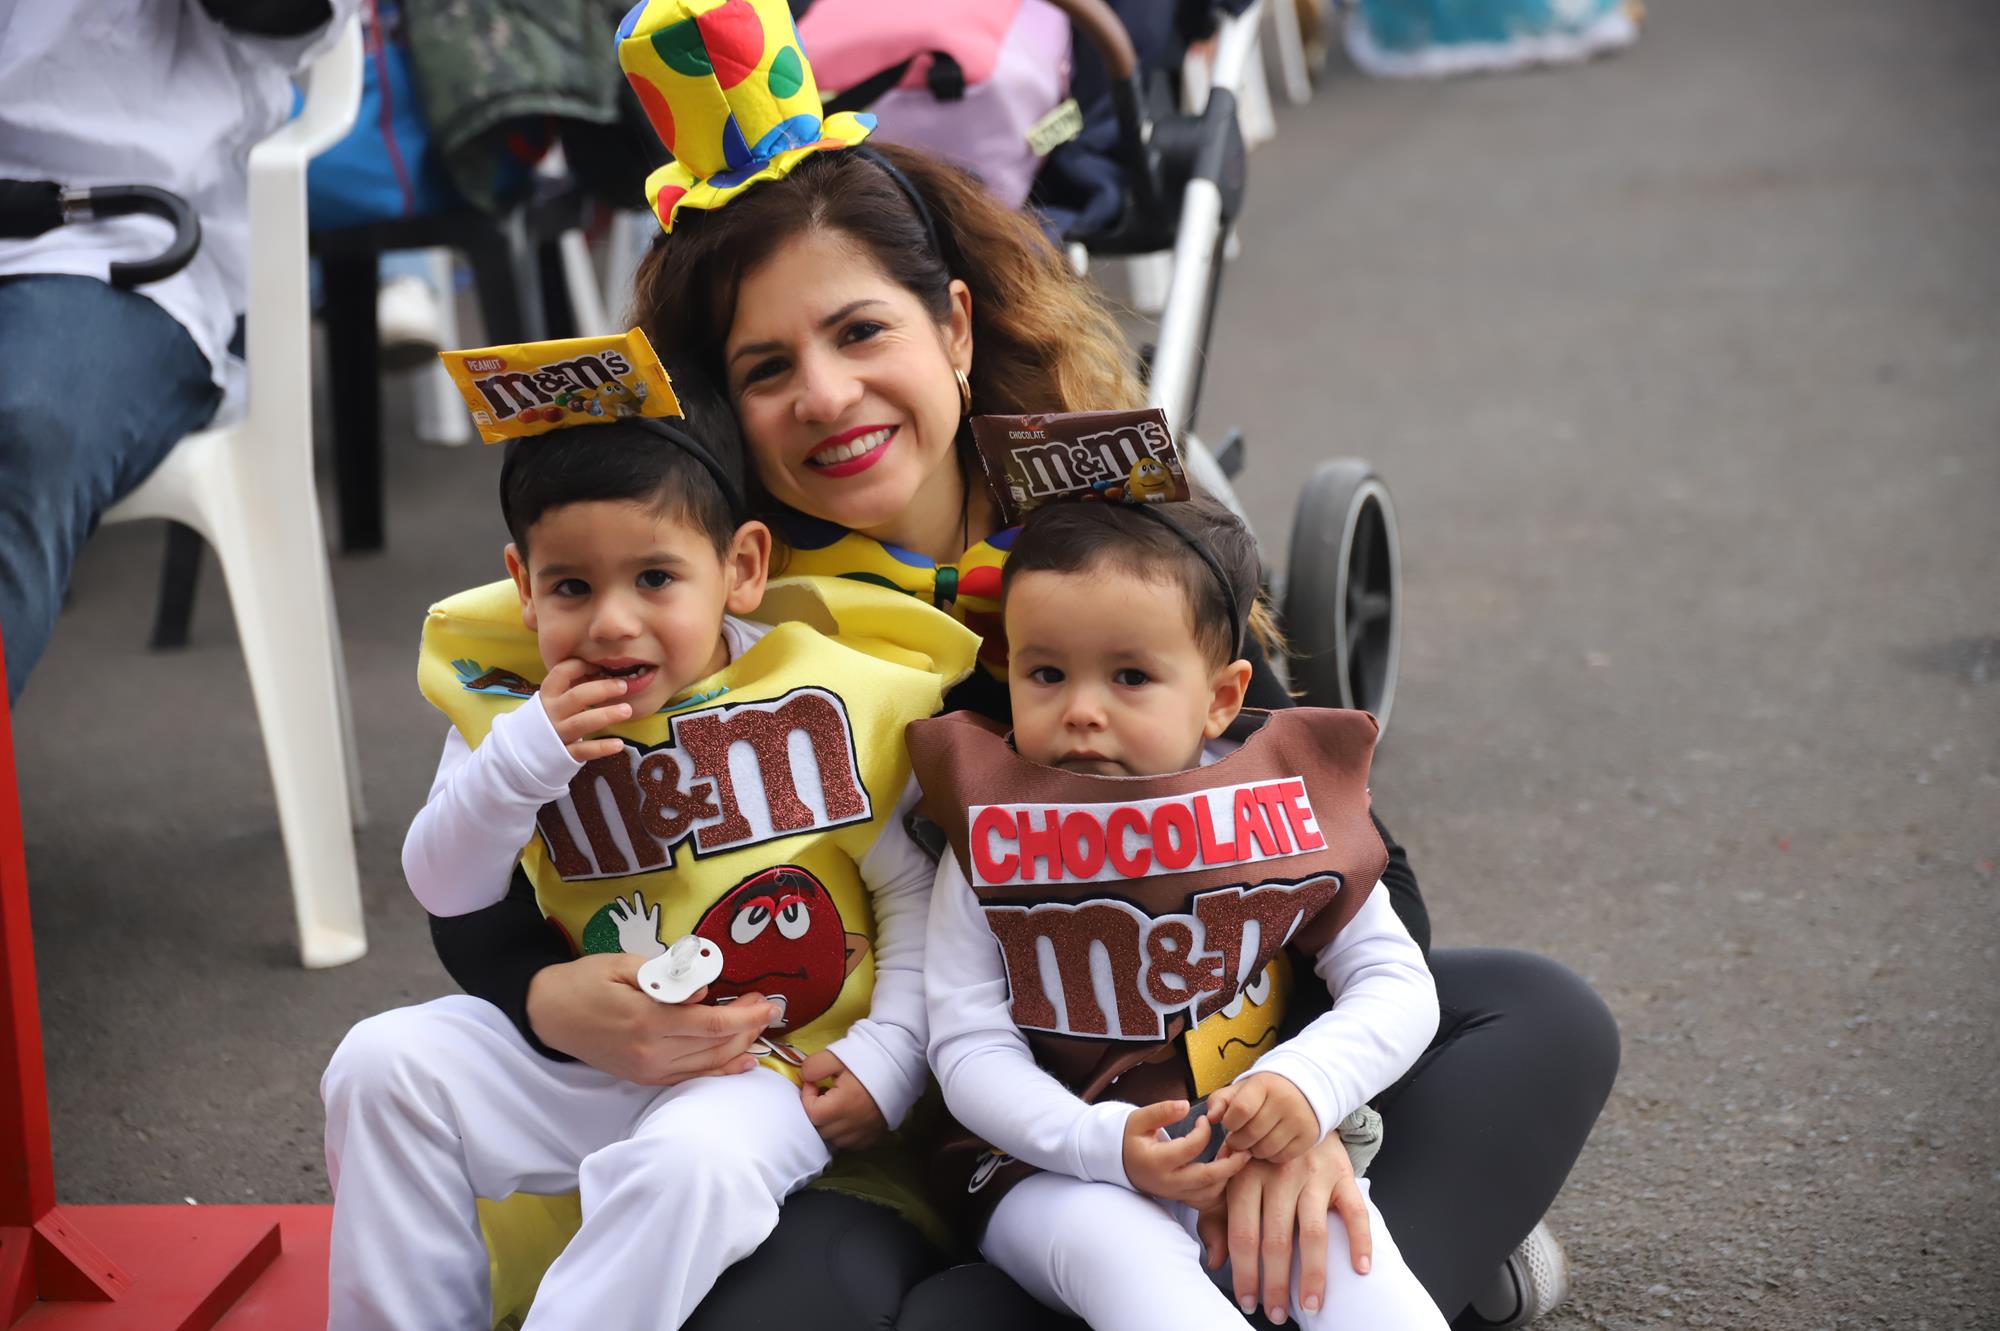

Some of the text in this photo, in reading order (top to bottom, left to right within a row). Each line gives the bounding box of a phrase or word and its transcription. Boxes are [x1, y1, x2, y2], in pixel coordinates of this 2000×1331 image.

[467, 359, 501, 371] PEANUT
[1009, 430, 1046, 440] CHOCOLATE
[970, 780, 1326, 885] CHOCOLATE
